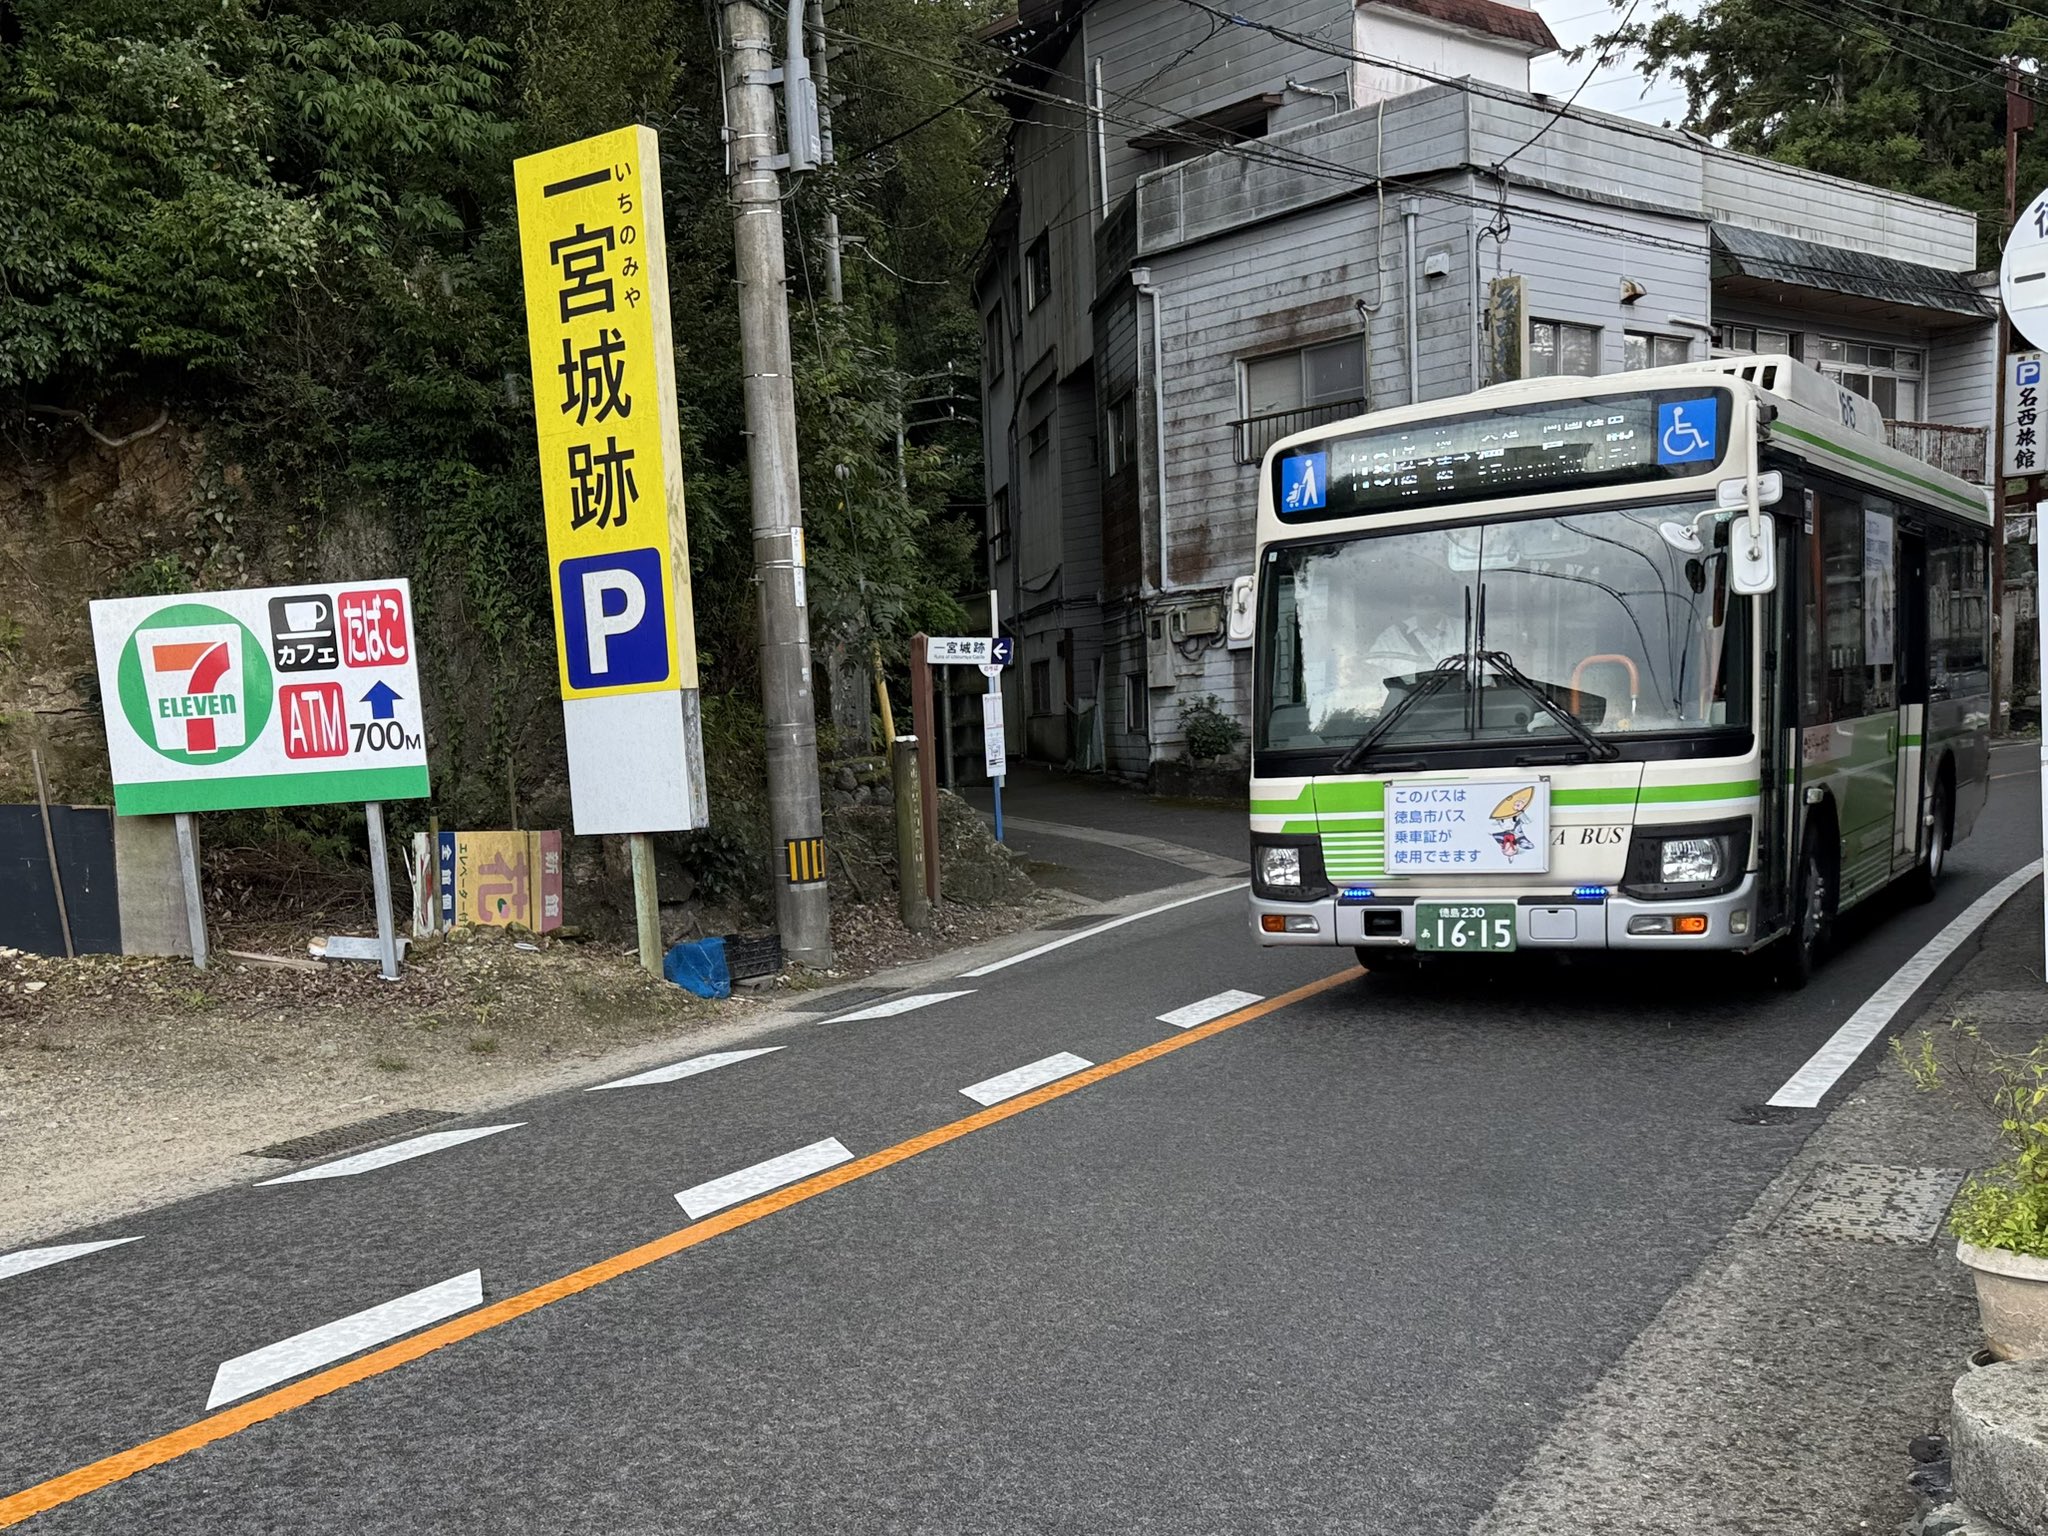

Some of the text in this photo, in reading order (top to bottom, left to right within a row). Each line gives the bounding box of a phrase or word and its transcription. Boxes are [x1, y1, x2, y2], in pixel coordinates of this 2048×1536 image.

[614, 162, 641, 309] いちのみや
[543, 167, 640, 531] 一宮城跡
[2019, 363, 2039, 385] P
[2014, 387, 2039, 470] 名西旅館
[344, 593, 405, 663] たばこ
[581, 568, 647, 675] P
[277, 645, 337, 666] カフェ
[933, 641, 986, 654] 一宮城跡
[289, 690, 344, 754] ATM
[1395, 789, 1467, 804] このバスは
[1394, 809, 1466, 825] 徳島市バス
[1394, 829, 1452, 844] 乗車証が
[1580, 826, 1624, 845] BUS
[1394, 850, 1482, 864] 使用できます
[477, 851, 529, 923] 花
[544, 851, 560, 918] 新館
[1439, 907, 1485, 918] 徳島 230
[1420, 919, 1511, 948] あ 16-15
